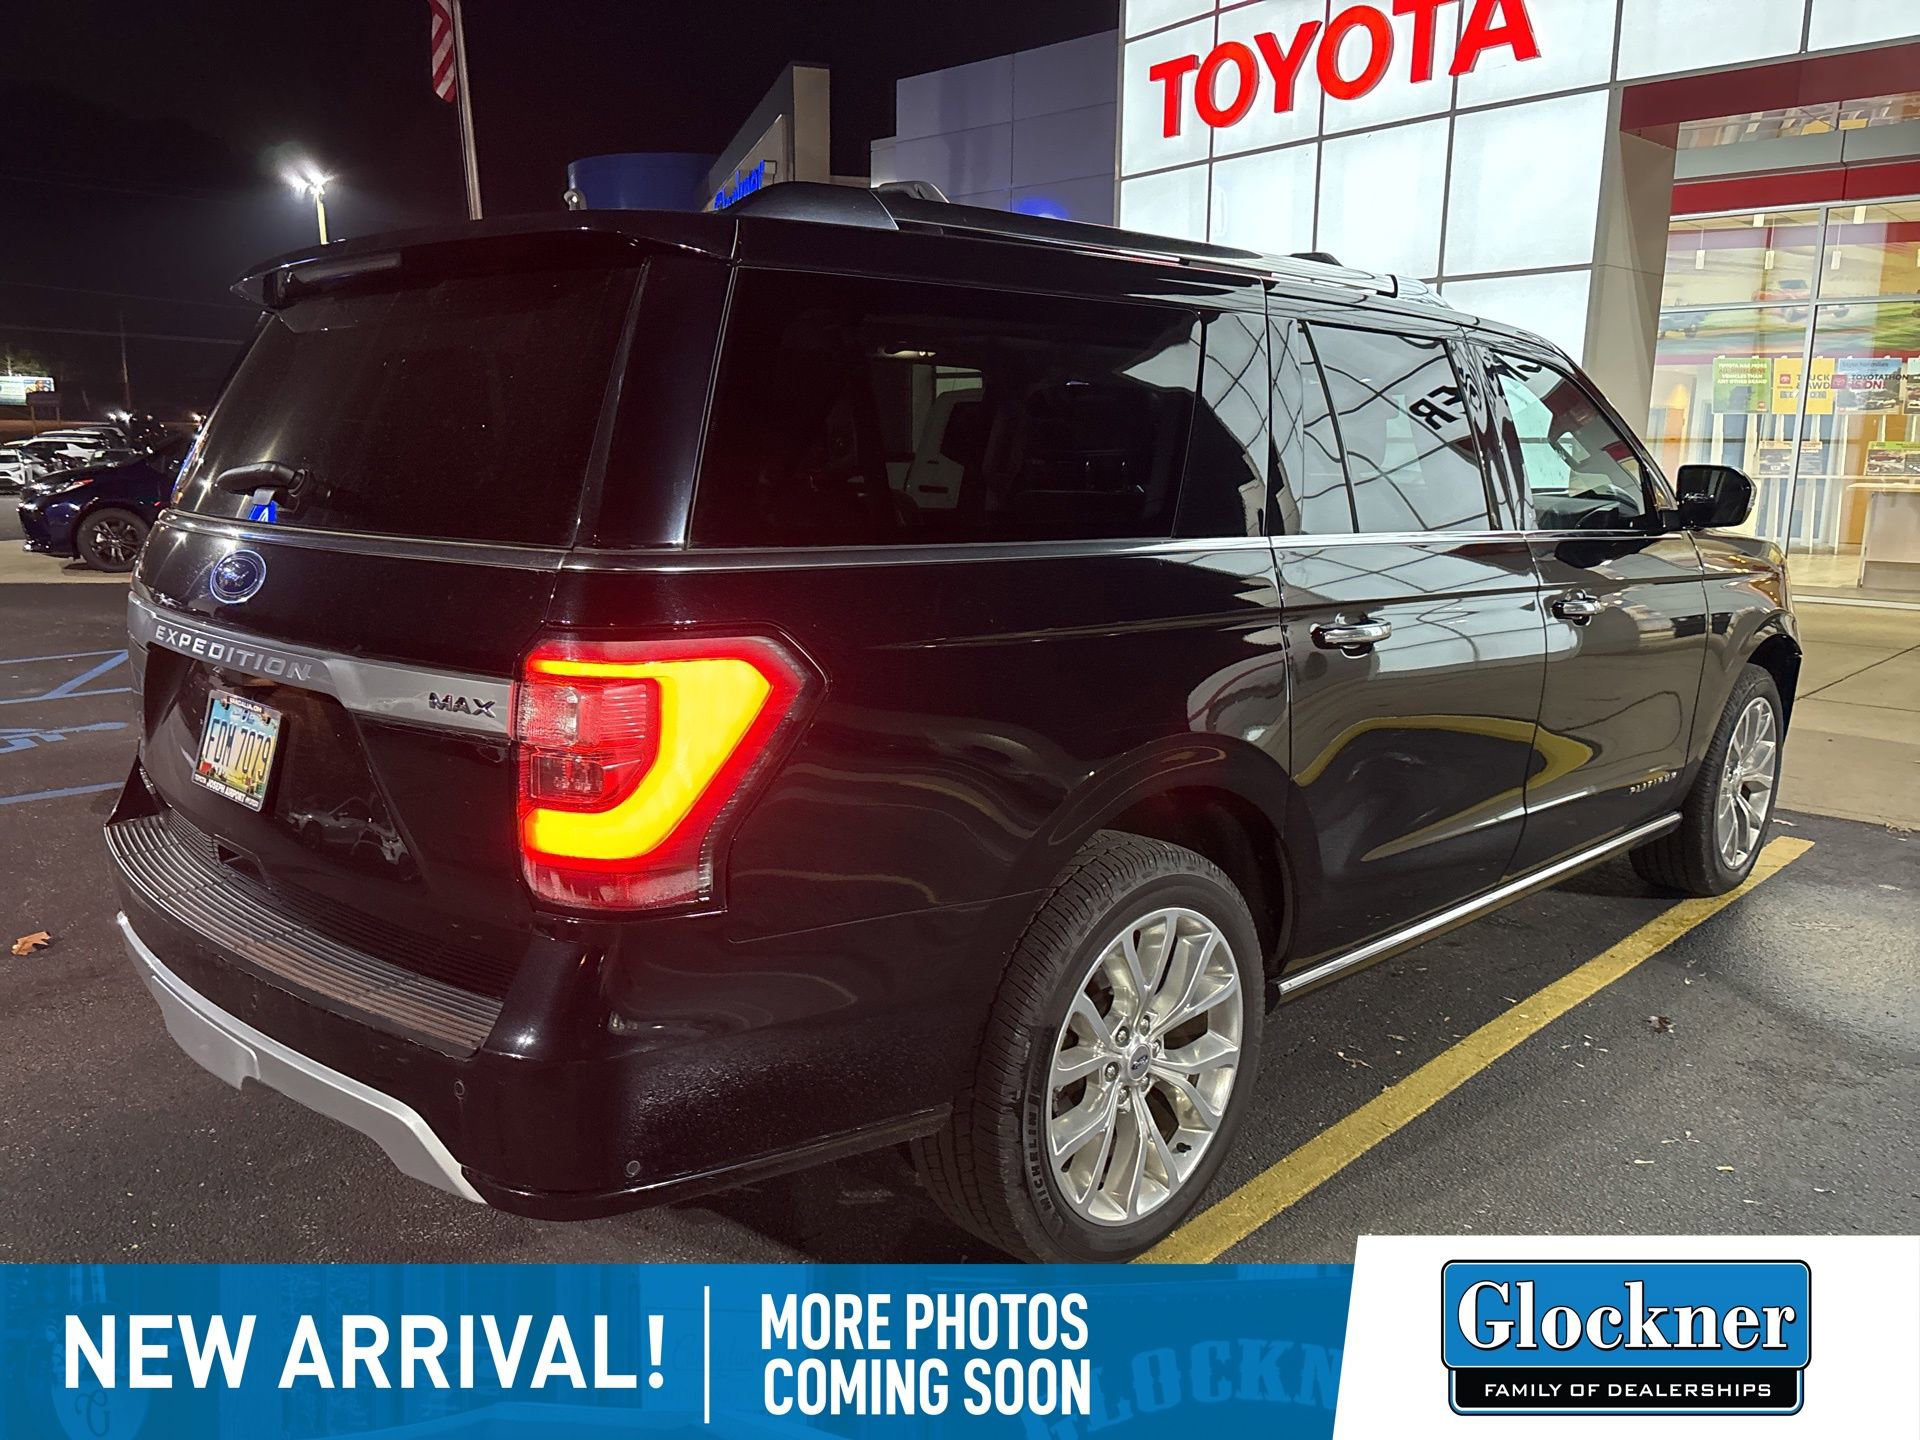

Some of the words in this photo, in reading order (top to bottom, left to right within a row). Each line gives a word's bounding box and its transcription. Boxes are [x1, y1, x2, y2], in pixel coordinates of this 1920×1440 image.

[1150, 0, 1541, 138] TOYOTA
[155, 624, 312, 681] EXPEDITION
[429, 692, 496, 718] MAX
[235, 728, 271, 780] 7079
